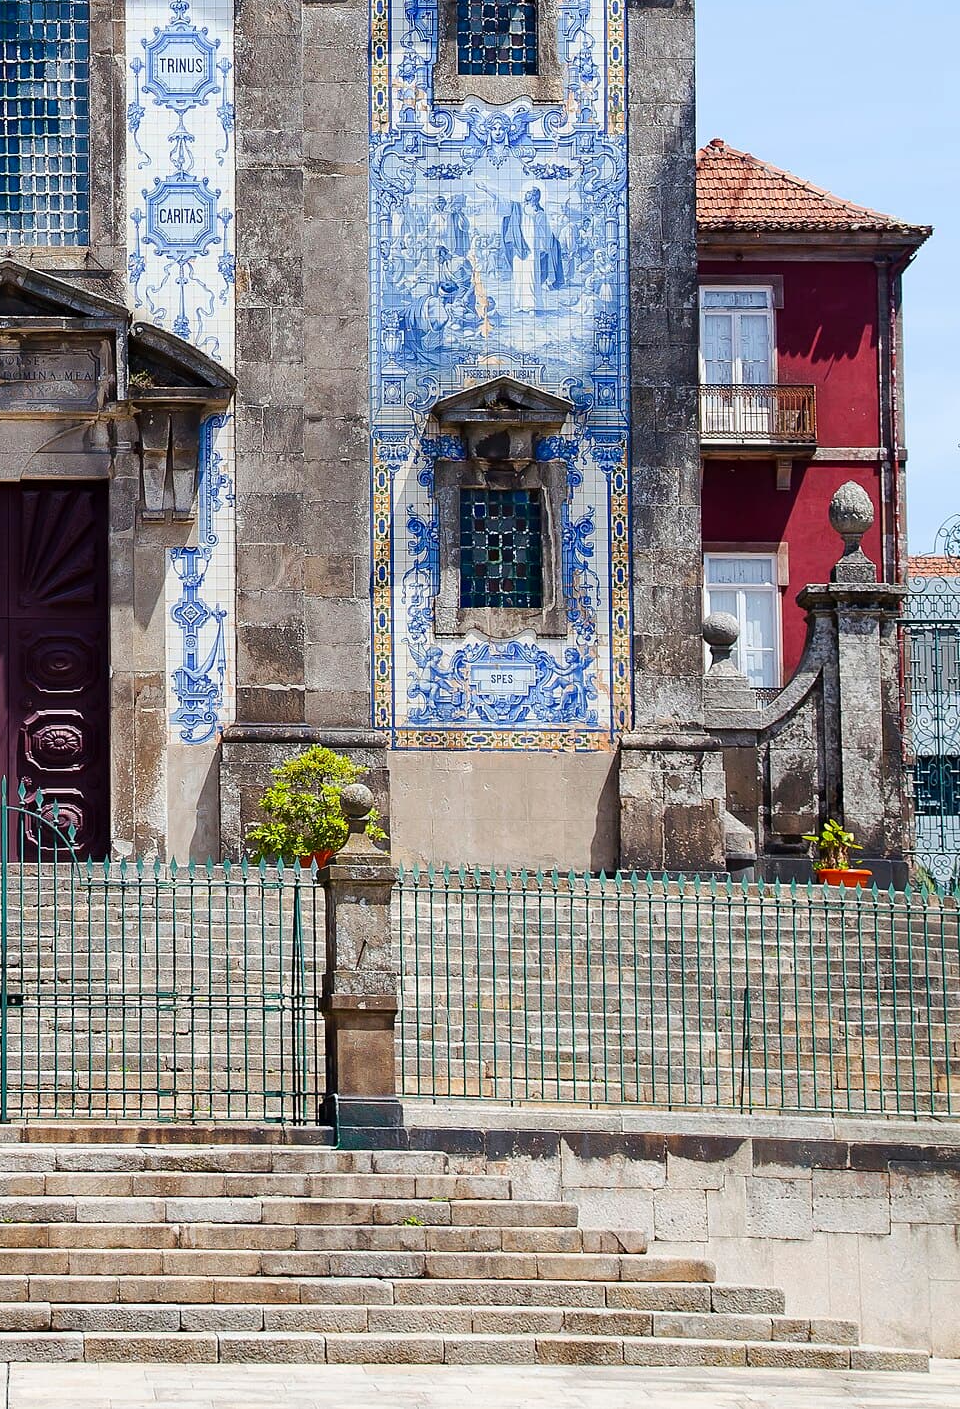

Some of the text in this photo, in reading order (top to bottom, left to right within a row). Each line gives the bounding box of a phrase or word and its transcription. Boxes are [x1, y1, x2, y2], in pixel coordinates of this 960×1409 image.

[159, 58, 203, 73] TRINUS
[159, 208, 204, 224] CARITAS
[490, 674, 513, 684] SPES
